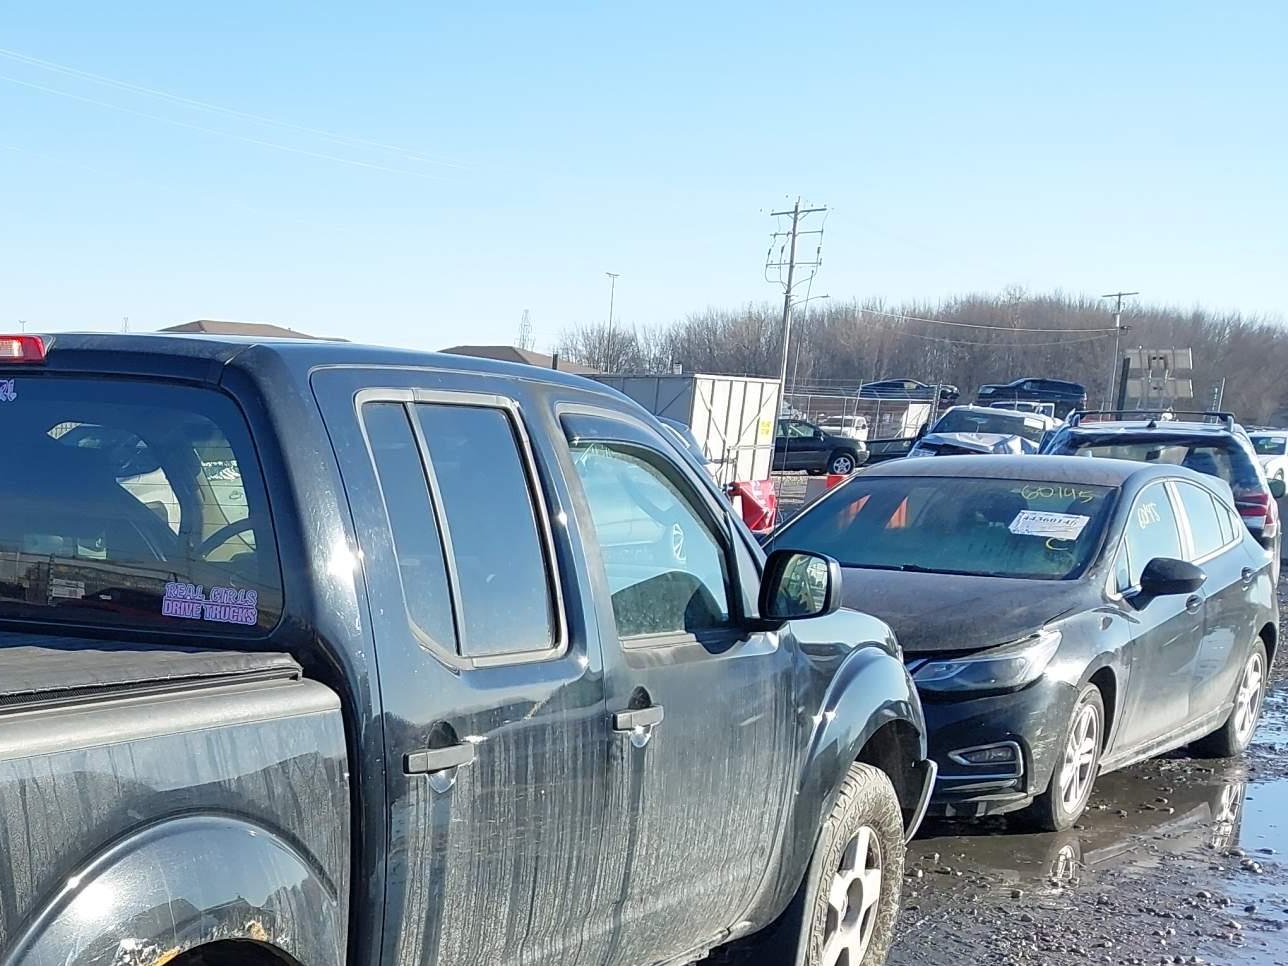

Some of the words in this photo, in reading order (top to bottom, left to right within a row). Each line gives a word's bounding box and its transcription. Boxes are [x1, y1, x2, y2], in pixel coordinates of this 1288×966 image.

[166, 582, 205, 601] REAL
[163, 599, 202, 619] DRIVE
[203, 603, 257, 625] TRUCKS
